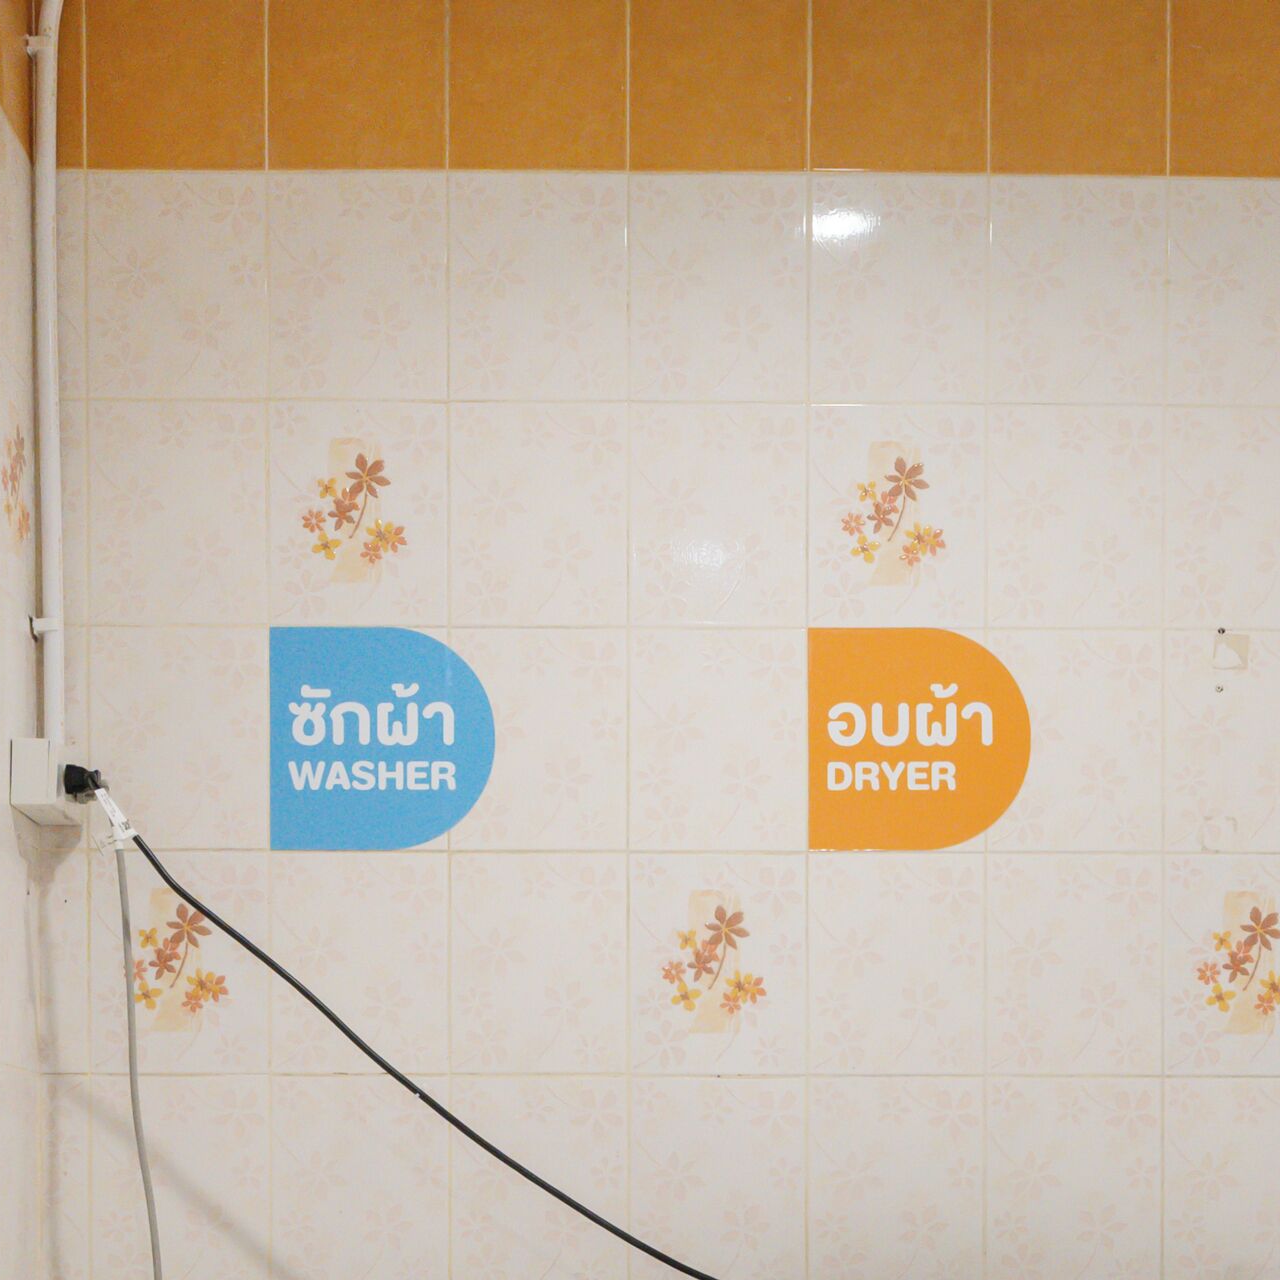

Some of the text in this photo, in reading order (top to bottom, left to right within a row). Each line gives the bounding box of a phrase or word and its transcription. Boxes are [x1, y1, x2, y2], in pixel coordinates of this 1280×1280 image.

[288, 683, 455, 746] ซักผ้า
[827, 683, 993, 747] อบผ้า
[288, 760, 456, 791] WASHER
[827, 761, 956, 791] DRYER
